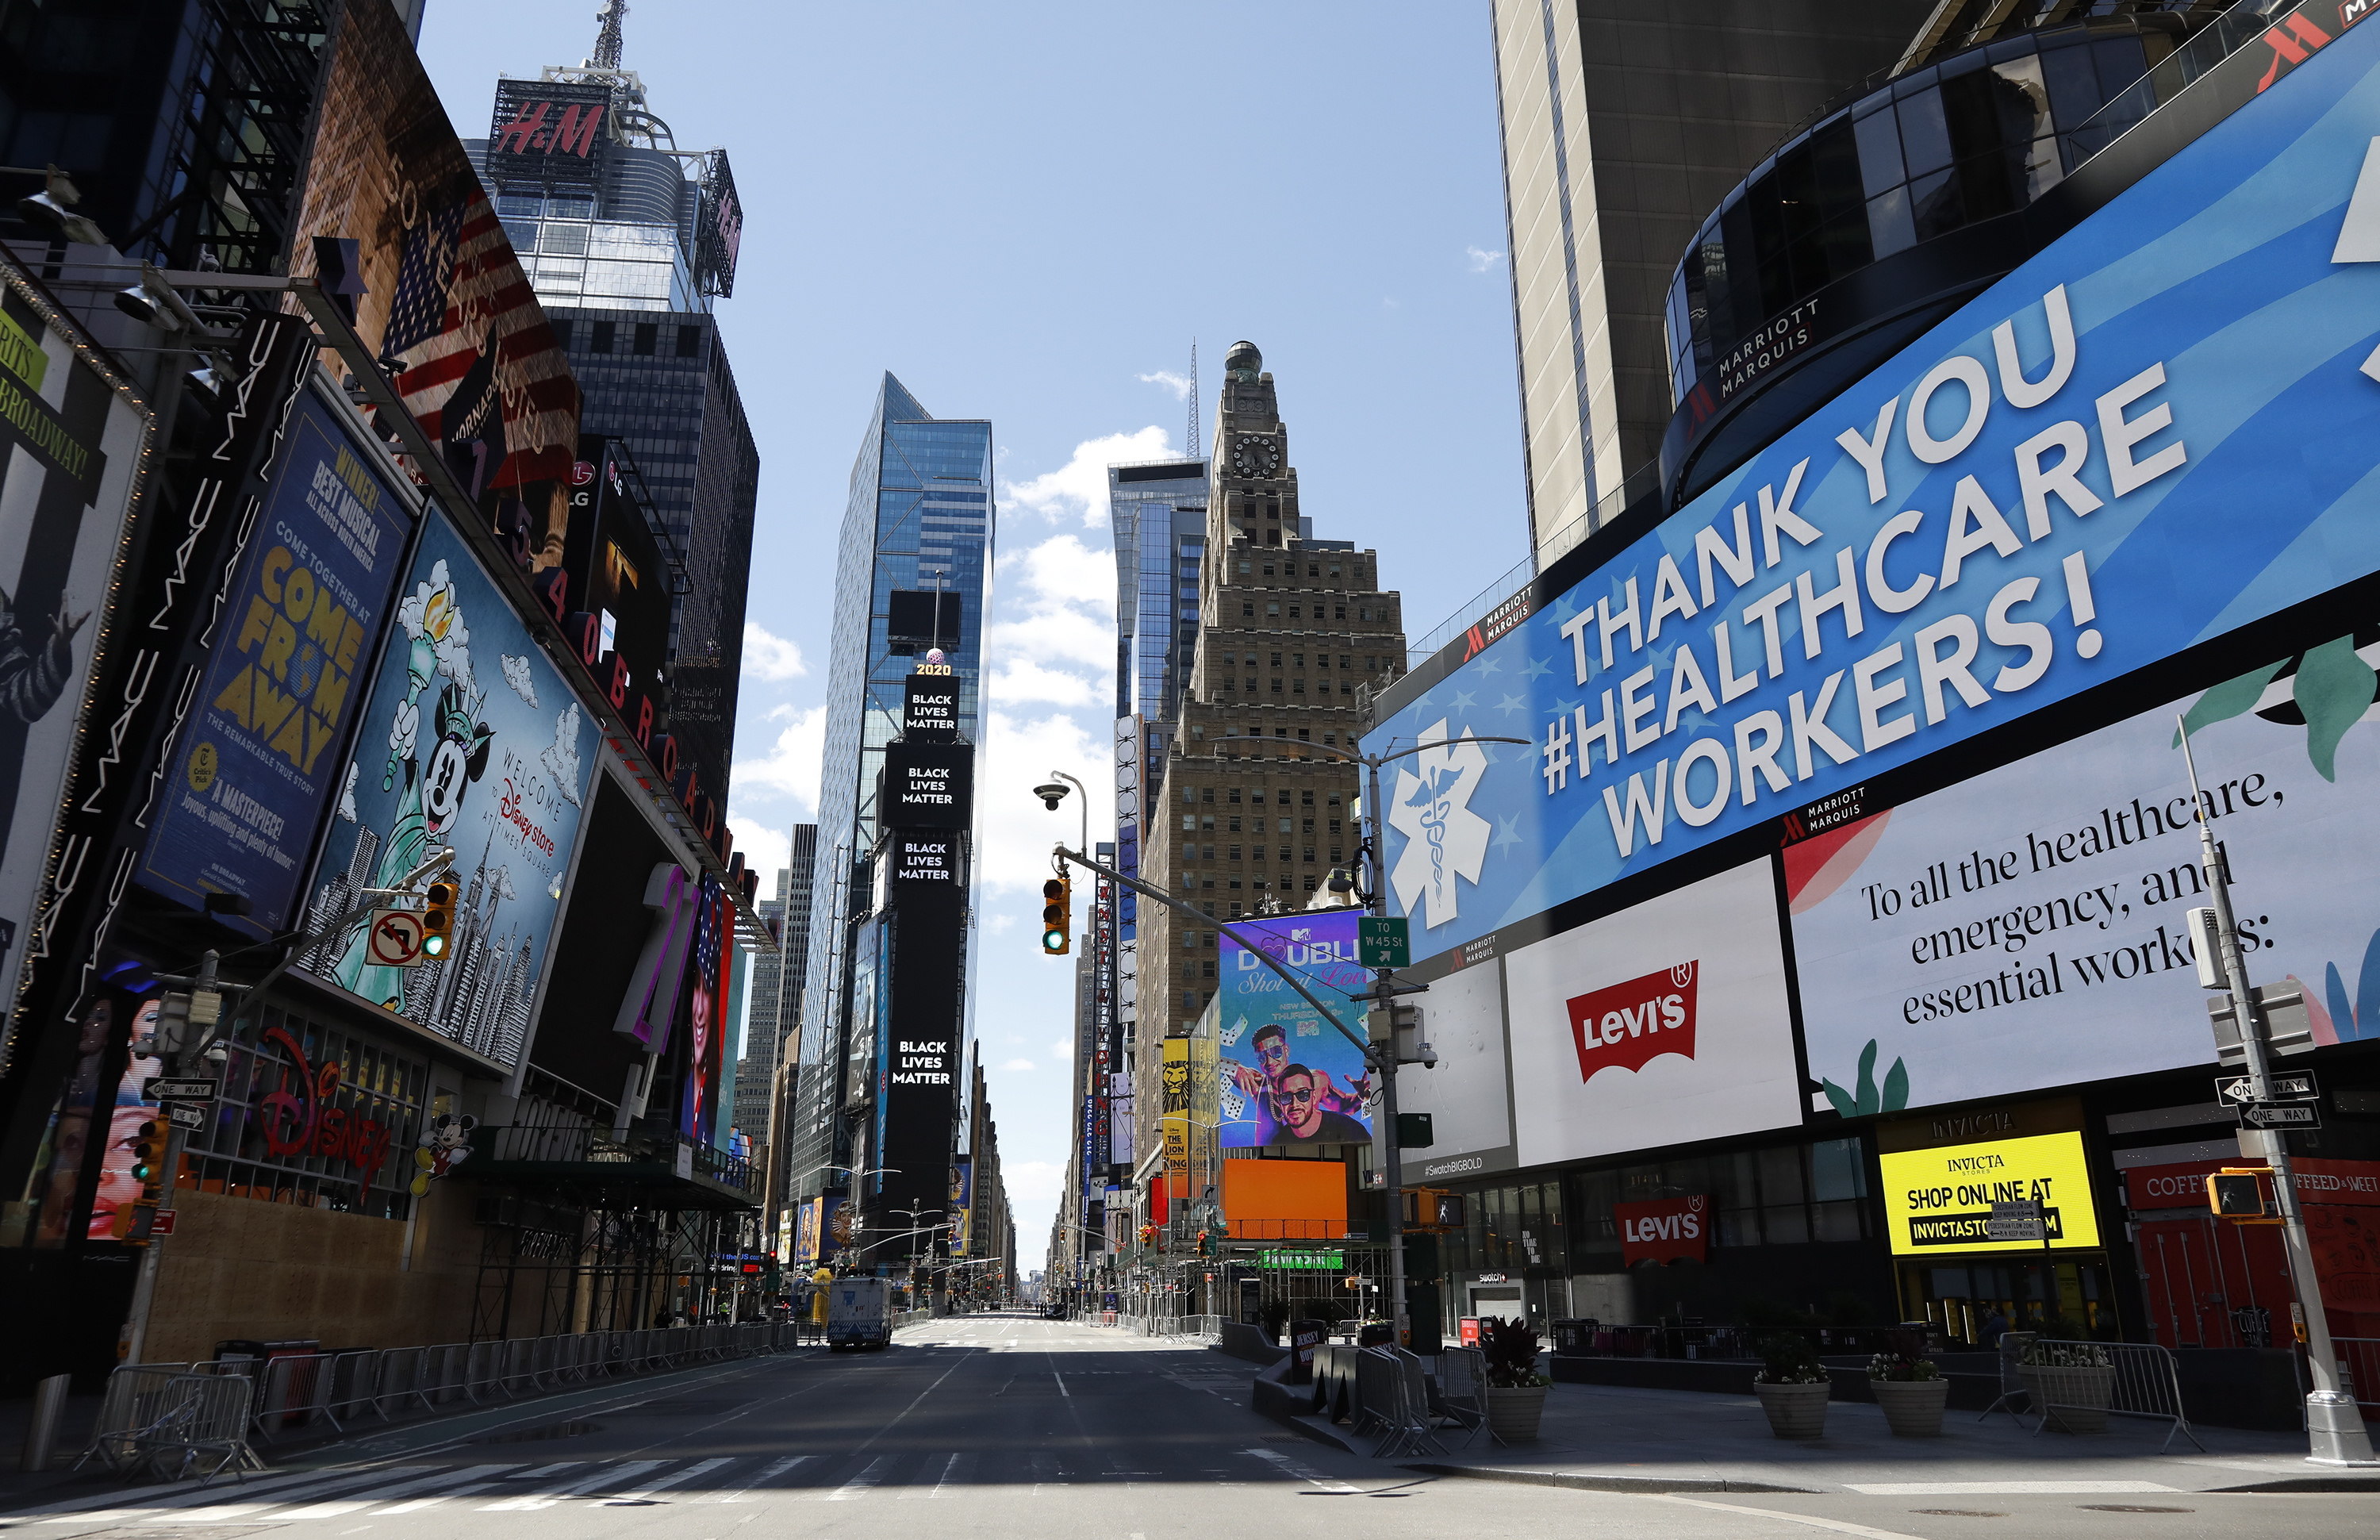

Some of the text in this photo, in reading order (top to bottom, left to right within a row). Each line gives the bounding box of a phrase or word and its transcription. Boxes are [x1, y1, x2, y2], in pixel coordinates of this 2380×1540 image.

[497, 102, 605, 159] H&M
[717, 190, 741, 270] H&M
[1719, 298, 1818, 378] MARRIOTT
[1722, 328, 1809, 398] MARQUIS
[0, 377, 88, 480] BROADWAY!
[335, 444, 380, 516] WINNER!
[614, 472, 623, 497] LG
[1560, 282, 2076, 687] THANK YOU
[312, 459, 381, 557] BEST MUSICAL
[570, 492, 589, 506] G
[305, 491, 375, 574] ALL ACROSS NORTH AMERICA
[276, 520, 371, 624] COME TOGETHER AT
[1543, 361, 2187, 796] #HEALTHCARE
[262, 546, 366, 674] COME
[1487, 586, 1534, 627] MARRIOTT
[1488, 605, 1529, 640] MARQUIS
[916, 664, 951, 675] 2020
[912, 694, 952, 705] BLACK
[1603, 551, 2103, 858] WORKERS!
[213, 662, 336, 776] AWAY
[915, 707, 948, 716] LIVES
[906, 719, 954, 729] MATTER
[207, 714, 315, 796] THE REMARKABLE TRUE STORY
[194, 767, 212, 776] Critic's
[610, 652, 760, 908] BROADWAY
[908, 768, 950, 778] BLACK
[491, 785, 498, 797] TO
[503, 747, 562, 823] WELCOME
[910, 781, 946, 791] LIVES
[902, 793, 952, 805] MATTER
[1808, 787, 1867, 818] MARRIOTT
[221, 783, 285, 842] MASTERPIECE!
[1809, 801, 1862, 831] MARQUIS
[181, 791, 207, 823] Joyous,
[208, 809, 237, 838] uplifting
[236, 827, 251, 843] and
[247, 833, 269, 857] plenty
[266, 843, 276, 860] of
[482, 810, 551, 880] AT TIMES SQUARE
[531, 825, 555, 858] store
[904, 843, 946, 854] BLACK
[1861, 772, 2285, 922] To all the healthcare,
[907, 856, 942, 866] LIVES
[211, 862, 219, 874] ON
[219, 864, 247, 886] BROADWAY
[899, 869, 949, 880] MATTER
[1376, 923, 1390, 932] TO
[1911, 882, 2130, 966] emergency,
[1365, 935, 1403, 947] W 45 St
[1465, 935, 1496, 954] MARRIOTT
[1466, 947, 1494, 963] MARQUIS
[1902, 912, 2276, 1027] essential works:
[1238, 972, 1285, 995] Shot
[1316, 964, 1368, 989] Lov
[1279, 1000, 1336, 1011] NEW SEON
[900, 1041, 946, 1054] BLACK
[902, 1057, 942, 1069] LIVES
[892, 1072, 950, 1085] MATTER
[2233, 1079, 2303, 1096] ON WAY
[154, 1085, 208, 1094] ONE WAY
[175, 1110, 200, 1122] ONE WAY
[2251, 1108, 2307, 1122] ONE WAY
[1931, 1111, 2017, 1140] INVICTA
[1165, 1144, 1184, 1156] LION
[1164, 1157, 1187, 1171] KING
[1425, 1158, 1483, 1176] #SwatchBIGBOLD
[1948, 1154, 2005, 1172] INVICTA
[1908, 1177, 2052, 1209] SHOP ONLINE AT
[2347, 1176, 2378, 1192] SWEET
[1522, 1231, 1530, 1239] NO
[1523, 1239, 1537, 1247] TIME
[1527, 1246, 1535, 1255] TO
[1531, 1254, 1541, 1264] DIE
[1480, 1273, 1503, 1283] swatch
[1296, 1330, 1319, 1346] JERSEY
